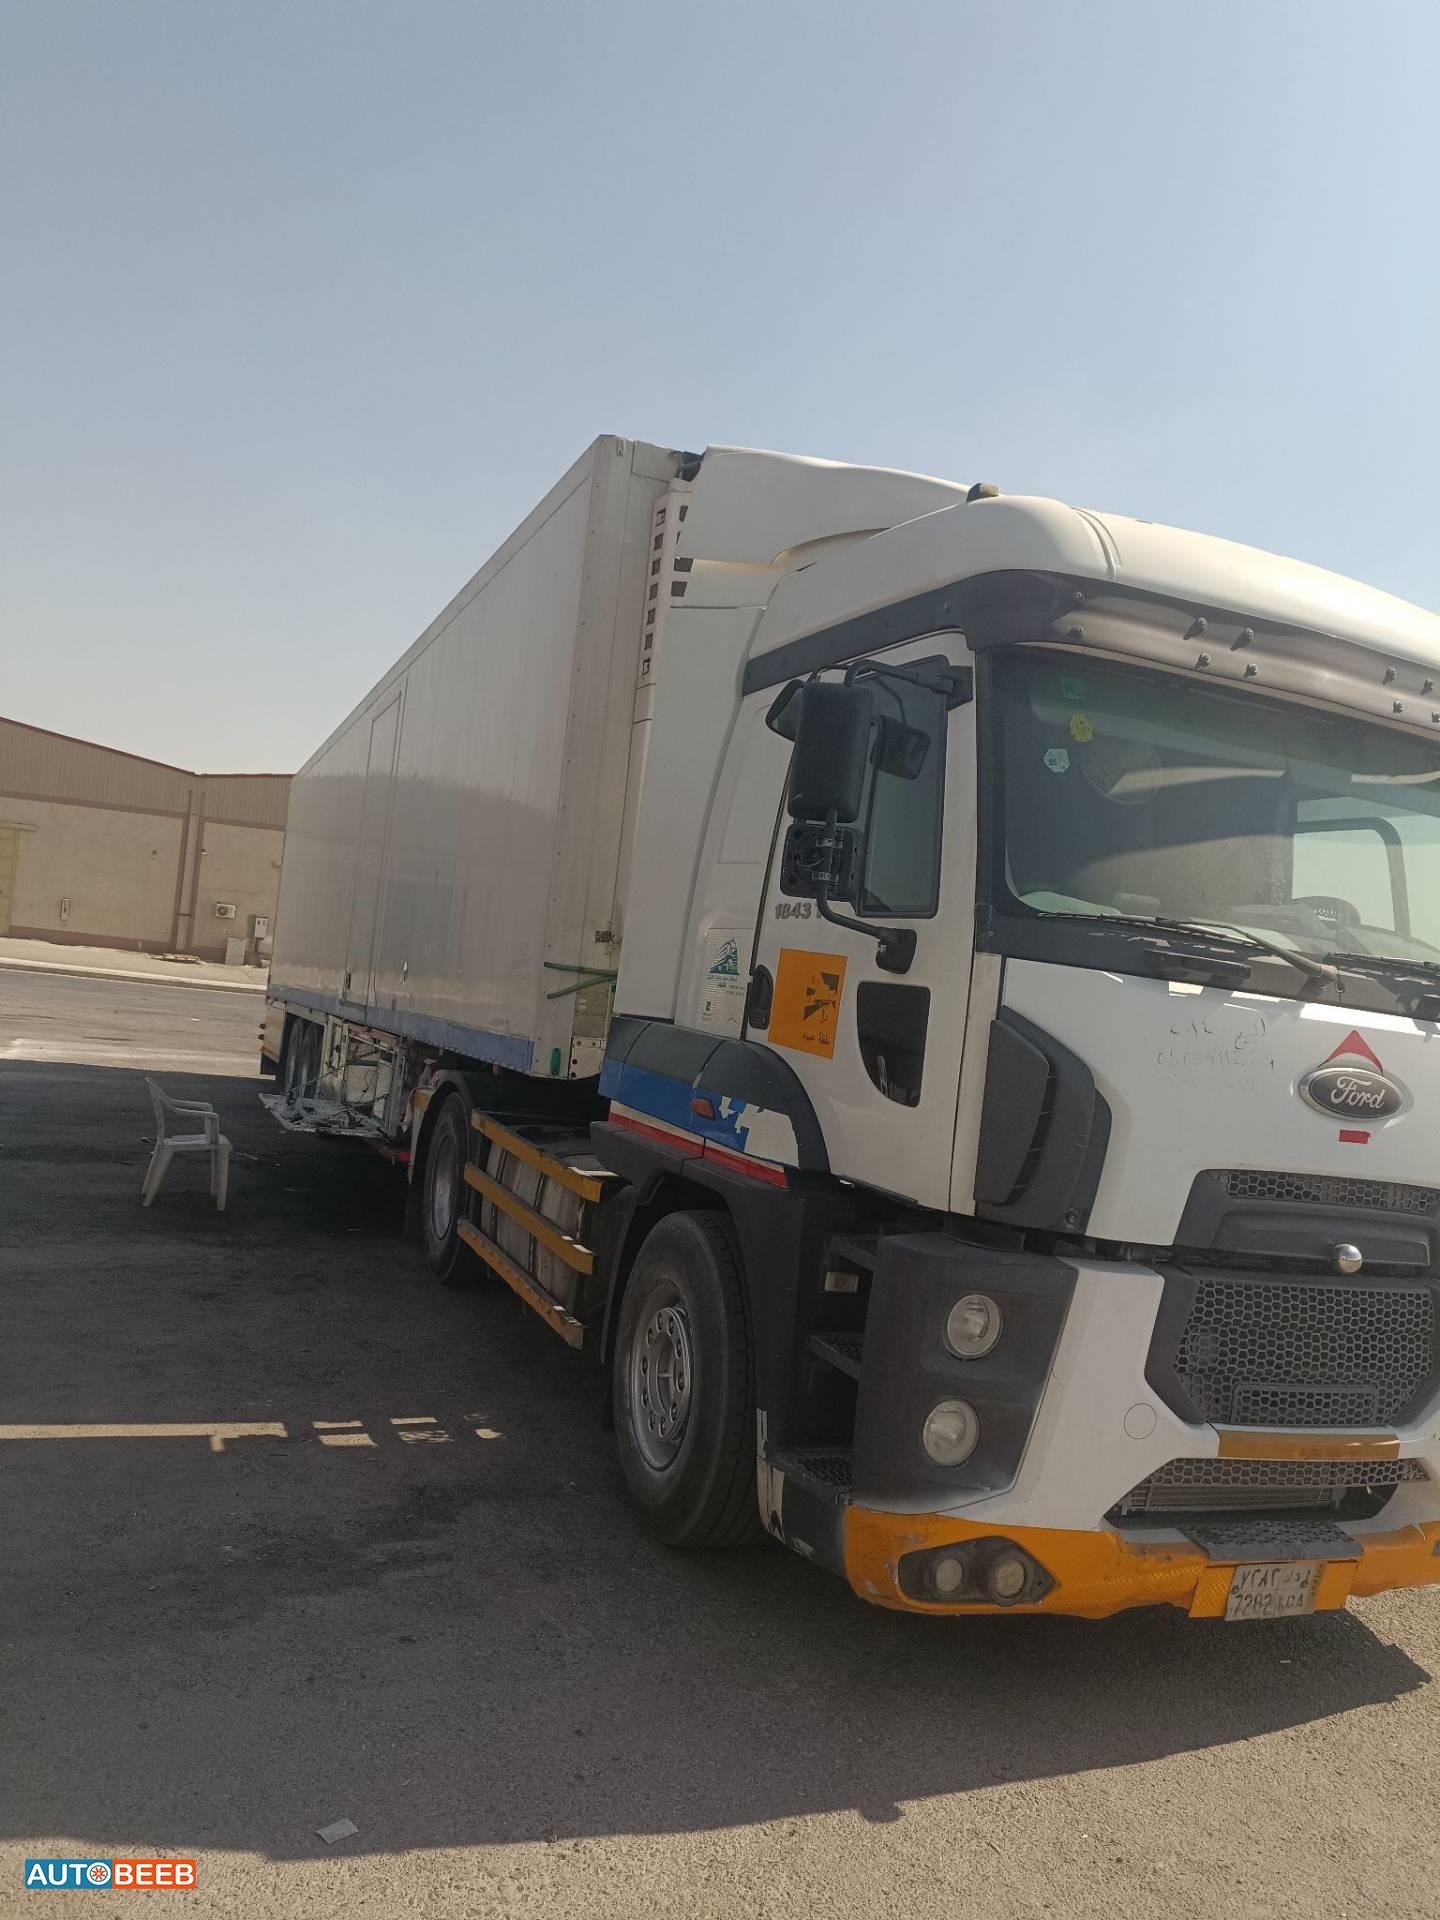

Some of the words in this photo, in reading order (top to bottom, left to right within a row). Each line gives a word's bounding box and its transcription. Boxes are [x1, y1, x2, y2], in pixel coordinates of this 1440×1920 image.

[774, 902, 811, 919] 1843
[1330, 1076, 1386, 1109] Ford
[1234, 1593, 1273, 1617] 7282
